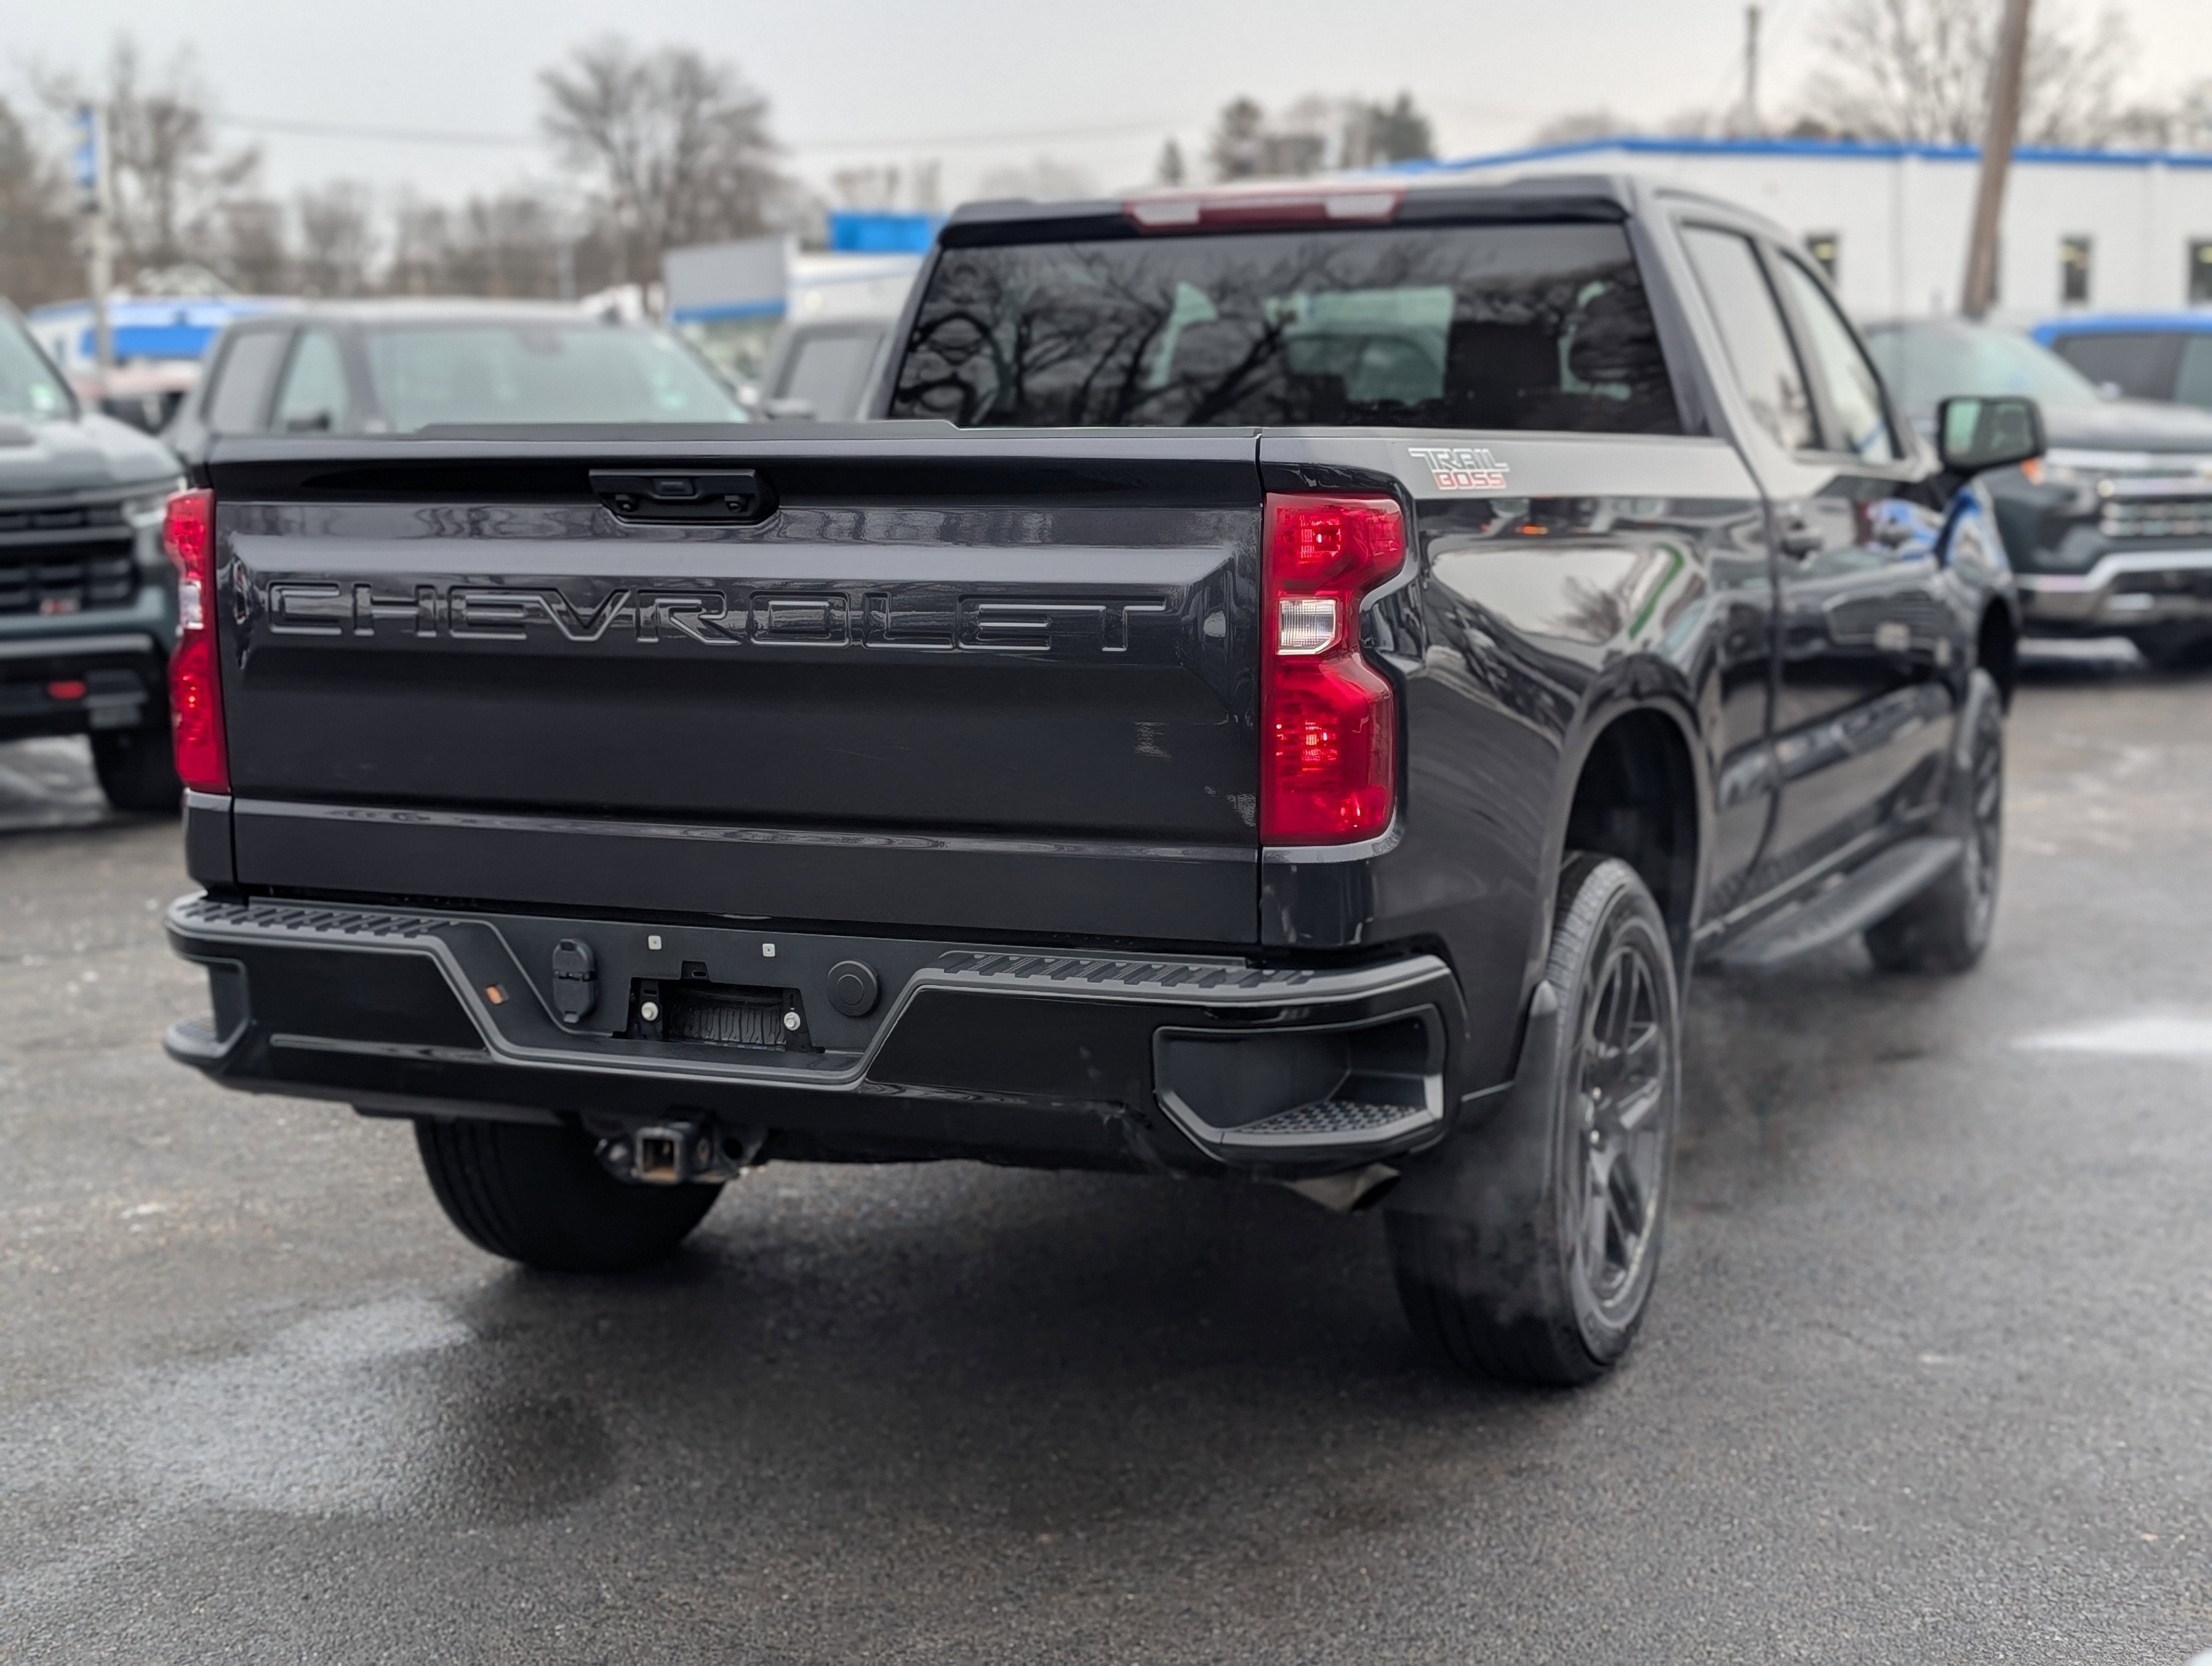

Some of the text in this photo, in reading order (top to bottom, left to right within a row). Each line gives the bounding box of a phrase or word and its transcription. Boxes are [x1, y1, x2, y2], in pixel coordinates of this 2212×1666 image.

[1408, 448, 1510, 472] TRAIL
[1433, 471, 1507, 490] BOSS
[268, 580, 1168, 652] CHEVROLET
